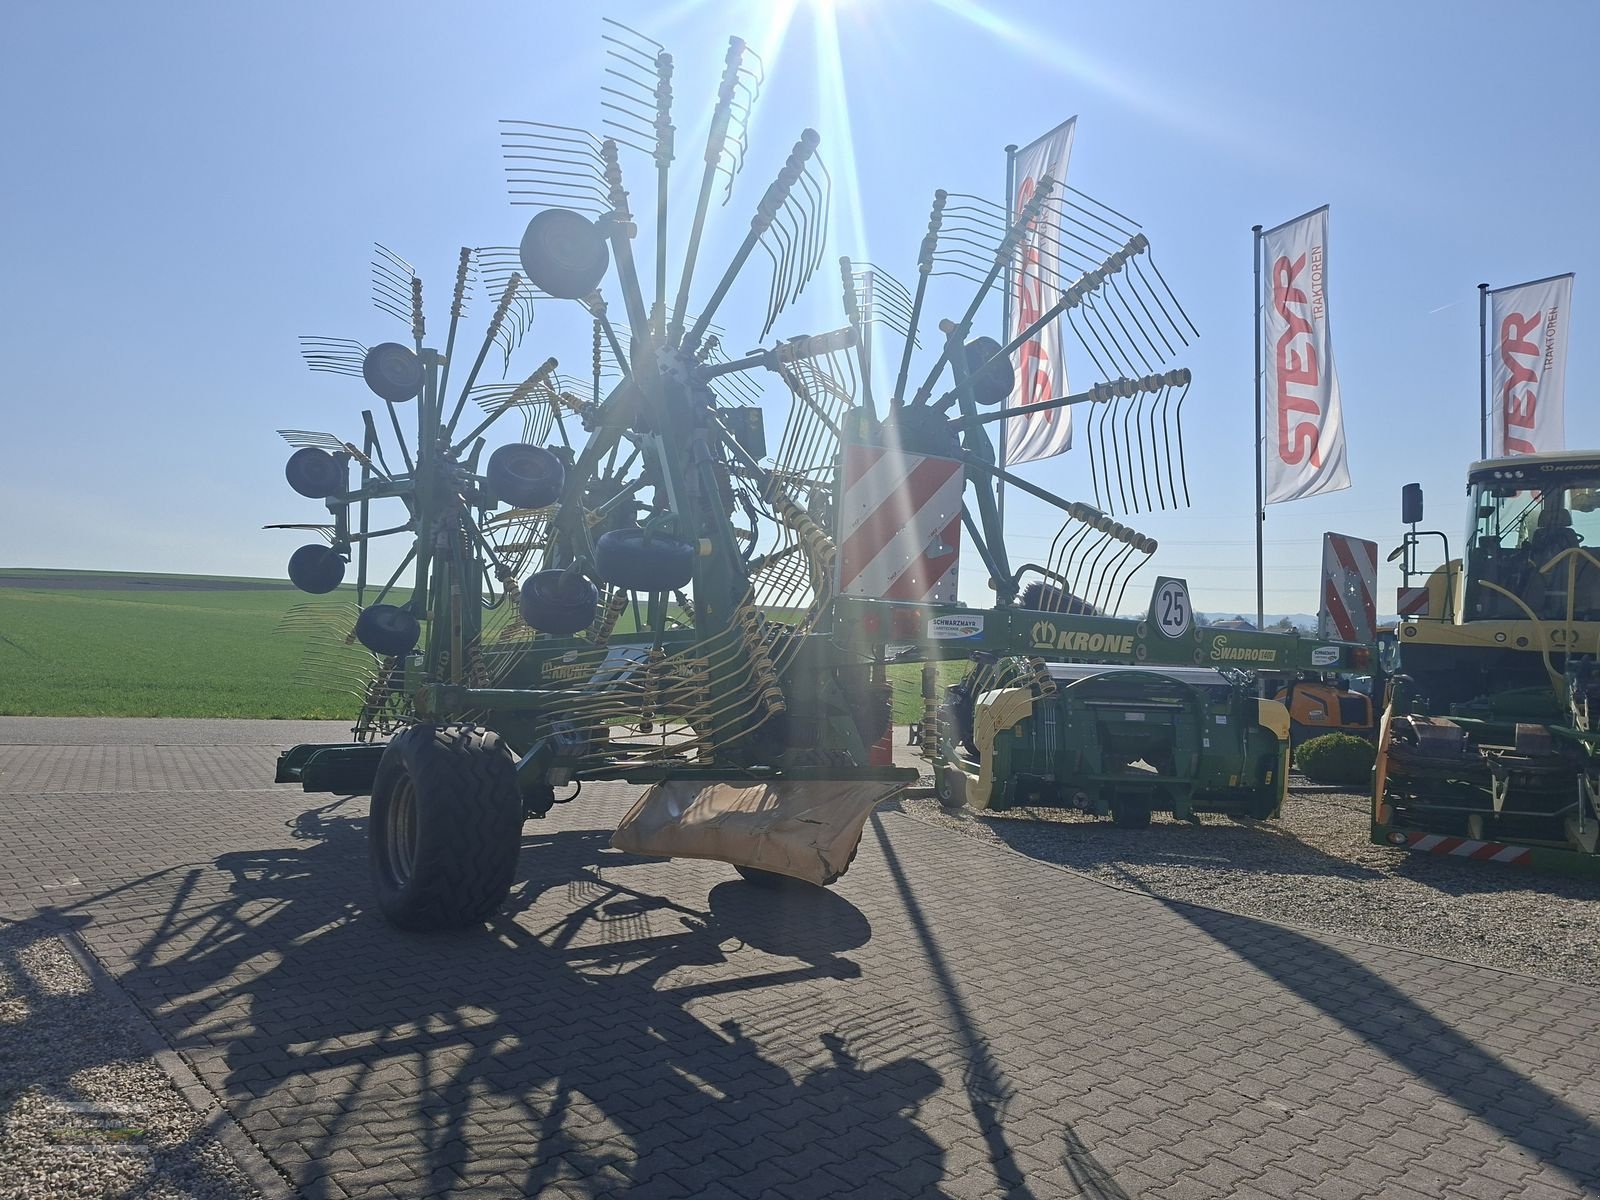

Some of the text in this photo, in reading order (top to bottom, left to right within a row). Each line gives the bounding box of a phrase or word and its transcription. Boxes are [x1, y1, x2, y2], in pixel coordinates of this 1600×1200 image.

[1312, 245, 1324, 321] TRAKTOREN
[1272, 252, 1321, 470] STEYR
[1544, 305, 1559, 372] TRAKTOREN
[1502, 310, 1542, 457] TEYR
[932, 619, 976, 627] SCHWARZMAYR
[1162, 590, 1184, 627] 25
[1057, 631, 1134, 654] KRONE
